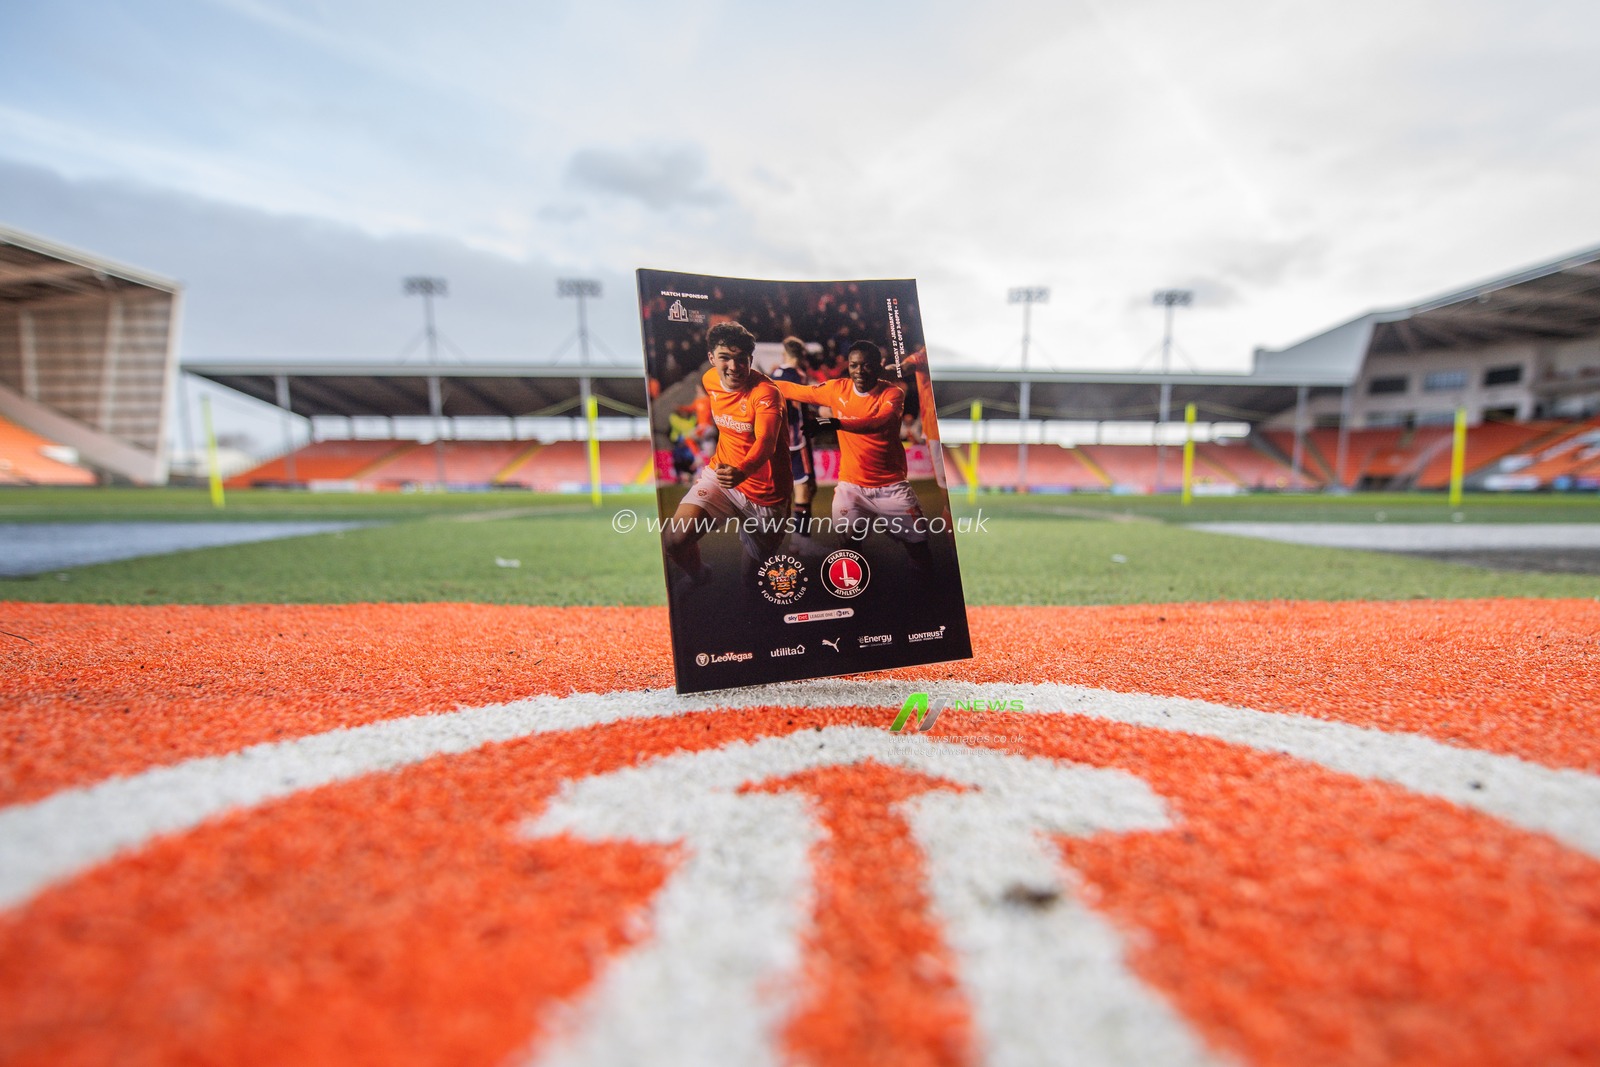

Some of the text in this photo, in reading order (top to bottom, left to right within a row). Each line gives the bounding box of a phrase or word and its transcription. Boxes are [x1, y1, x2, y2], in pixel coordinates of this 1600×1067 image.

[661, 290, 708, 300] MATCH SPONSOR
[888, 313, 896, 340] JANUARY
[894, 348, 902, 378] SATURDAY
[713, 414, 753, 433] eoVegas
[827, 551, 860, 564] CHARLTON
[757, 554, 806, 577] BLACKPOOL
[761, 586, 807, 605] FOOTBALL CLUB
[834, 586, 861, 596] ATHLETIC
[908, 630, 944, 640] LIONTRUST
[711, 652, 753, 662] LeoVegas
[770, 646, 797, 657] utilita
